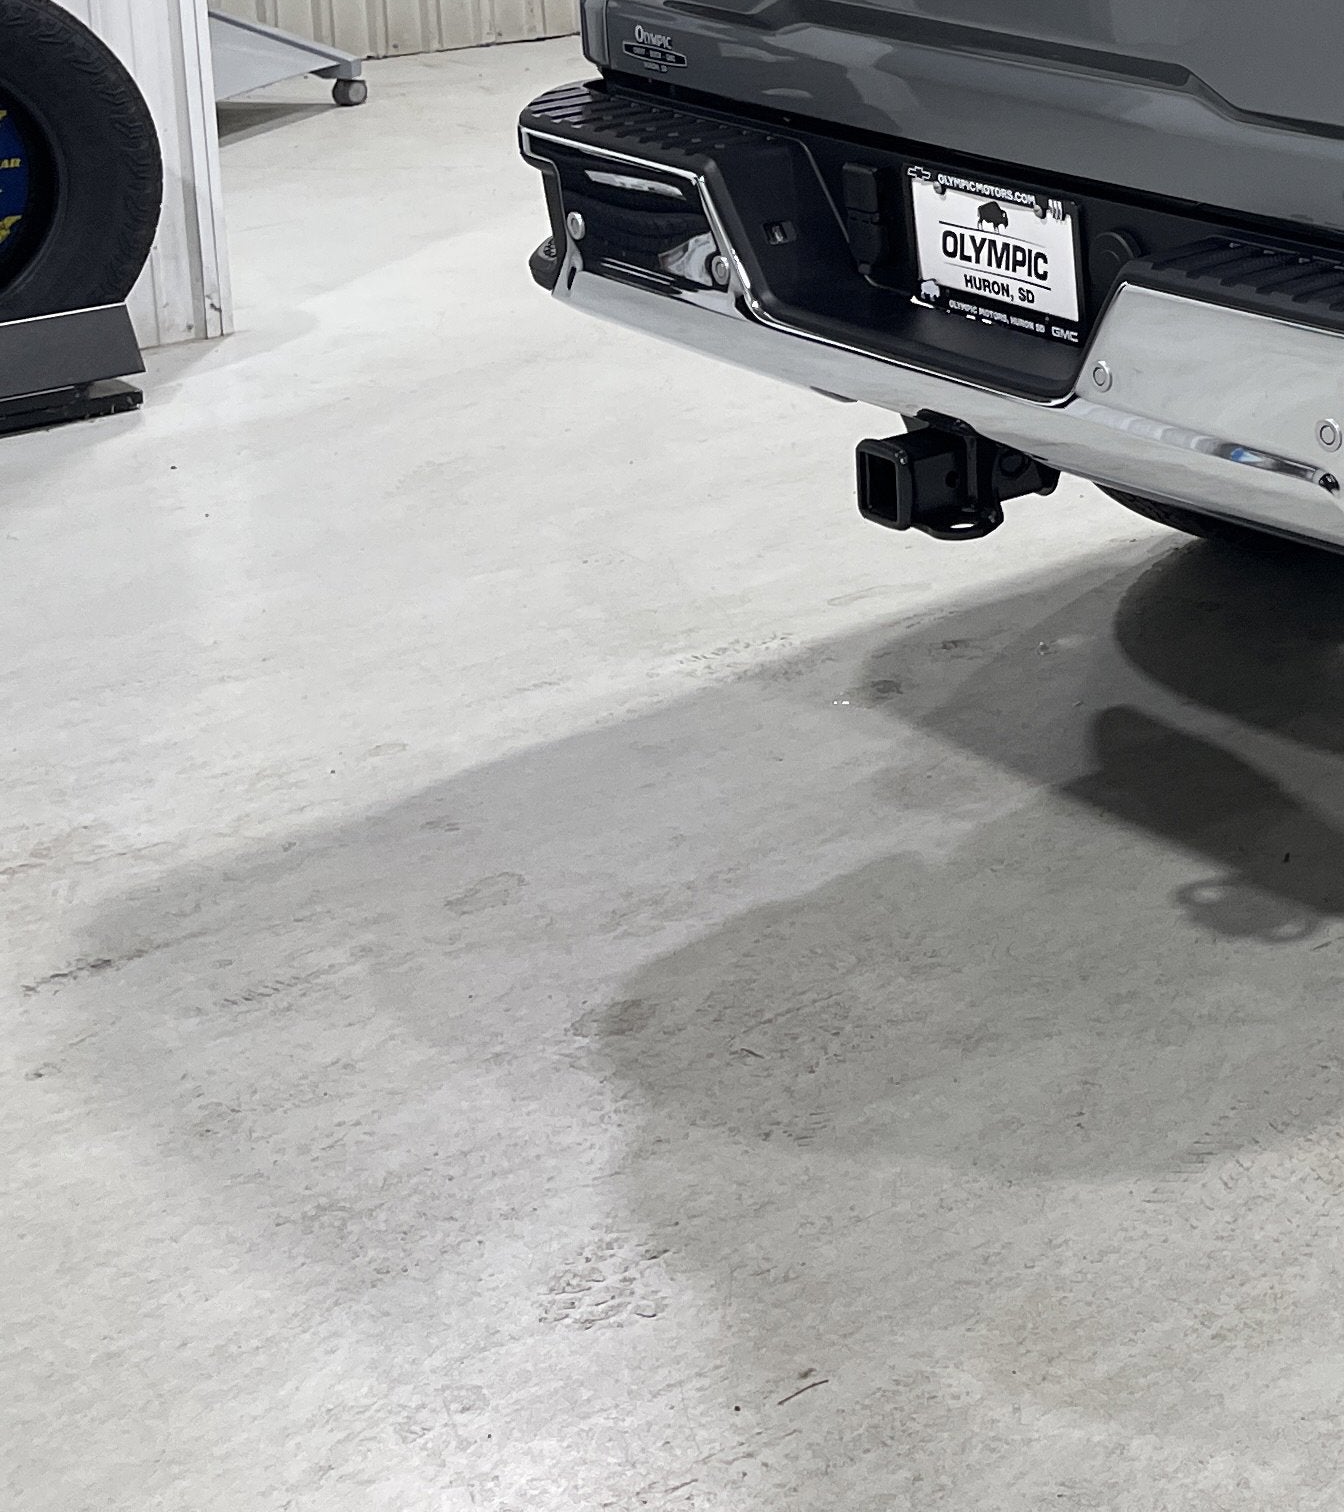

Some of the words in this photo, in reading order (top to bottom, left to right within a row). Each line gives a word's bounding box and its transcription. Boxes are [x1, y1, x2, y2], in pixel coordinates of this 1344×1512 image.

[937, 173, 1036, 206] OLYMPICMOTORS.COM
[941, 230, 1048, 281] OLYMPIC
[963, 273, 1014, 302] HURON,
[1018, 288, 1035, 304] SD
[1051, 326, 1079, 342] GMC
